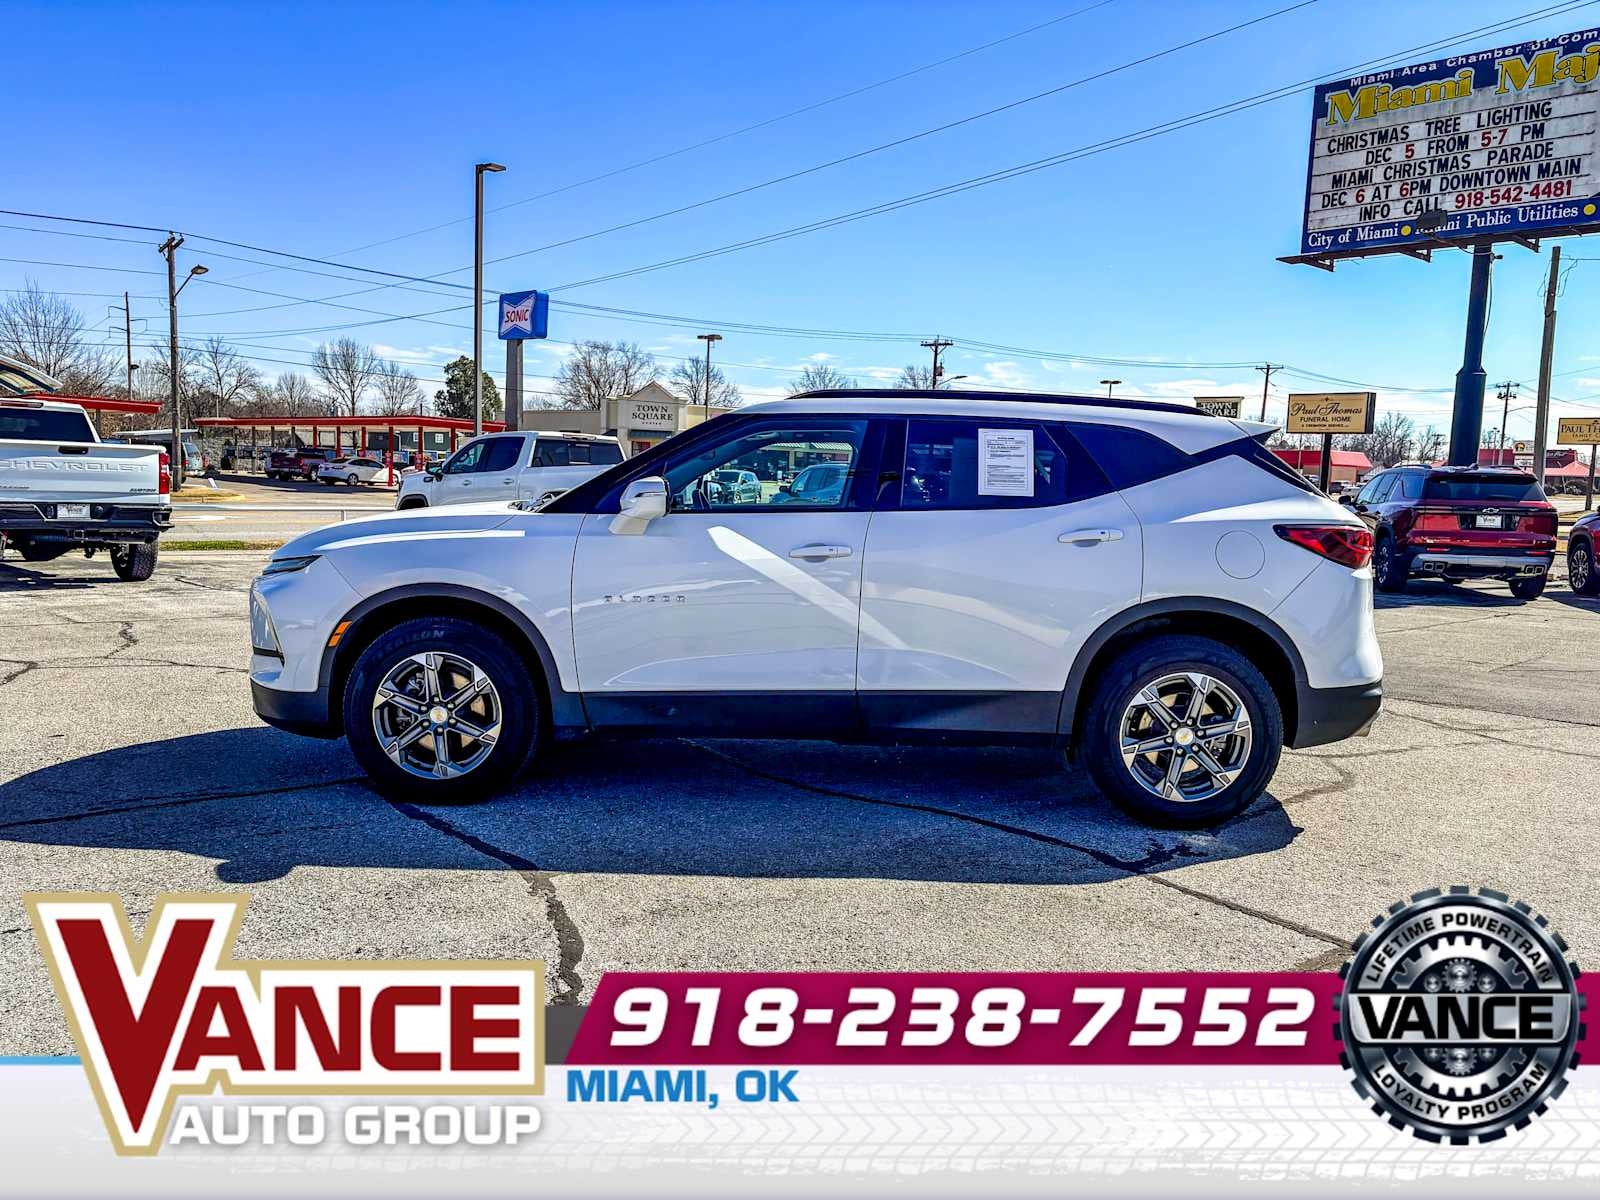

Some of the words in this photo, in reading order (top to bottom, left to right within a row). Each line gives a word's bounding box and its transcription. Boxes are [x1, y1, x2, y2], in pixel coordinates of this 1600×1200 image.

[1350, 71, 1395, 88] Miami
[1401, 61, 1438, 77] Area
[1446, 45, 1522, 67] Chamber
[1325, 67, 1473, 126] Miami
[1327, 125, 1410, 154] CHRISTMAS
[1425, 116, 1461, 137] TREE
[1476, 101, 1553, 129] LIGHTING
[1365, 147, 1392, 166] DEC
[1404, 143, 1415, 159] 5
[1427, 133, 1470, 156] FROM
[1481, 127, 1509, 147] 5-7
[1520, 122, 1545, 141] PM
[1321, 191, 1348, 209] DEC
[1355, 188, 1366, 204] 6
[1371, 184, 1393, 202] AT
[1400, 178, 1432, 199] 6PM
[1440, 164, 1531, 193] DOWNTOWN
[1537, 157, 1582, 179] MAIN
[1331, 168, 1374, 190] MIAMI
[1383, 153, 1471, 181] CHRISTMAS
[1487, 141, 1554, 166] PARADE
[1359, 203, 1391, 221] INFO
[1403, 196, 1442, 216] CALL
[1455, 179, 1573, 210] 918-542-4481
[1308, 232, 1334, 250] City
[1338, 228, 1353, 244] of
[1356, 223, 1399, 242] Miami
[1466, 211, 1512, 229] Public
[1518, 203, 1579, 223] Utilities
[504, 309, 530, 324] SONIC
[631, 412, 673, 421] SQUARE
[635, 404, 668, 413] TOWN
[1200, 402, 1233, 410] TOWN
[1290, 402, 1320, 416] Paul
[1319, 402, 1362, 416] Thomas
[1561, 424, 1583, 433] PAUL
